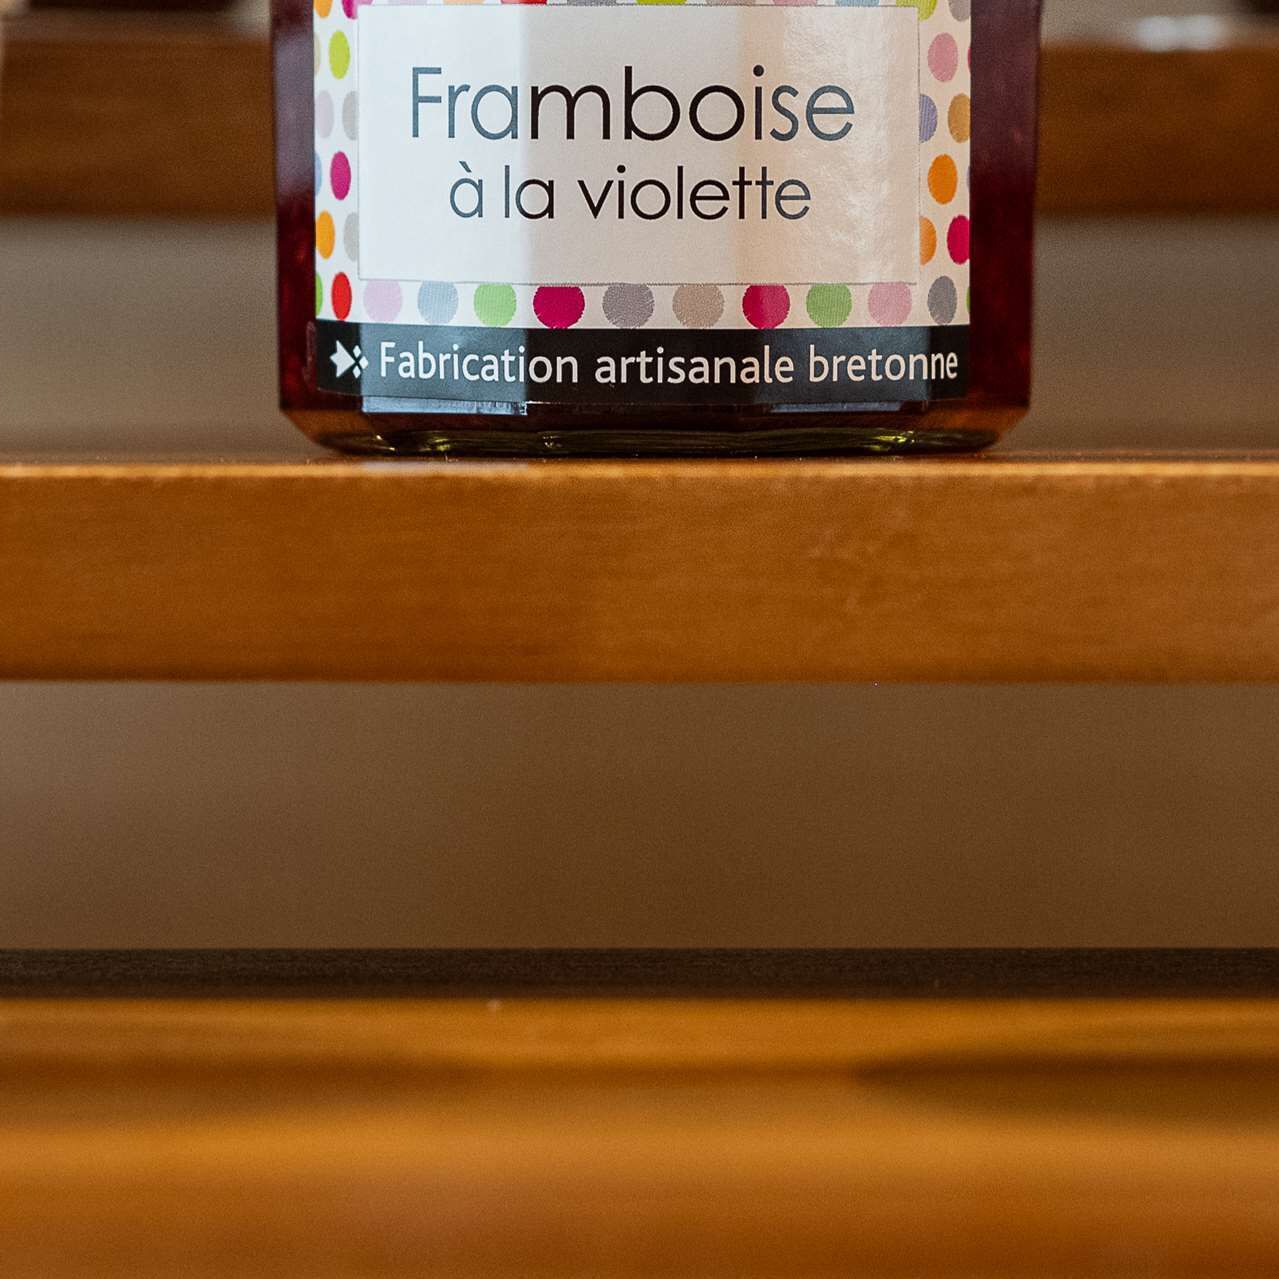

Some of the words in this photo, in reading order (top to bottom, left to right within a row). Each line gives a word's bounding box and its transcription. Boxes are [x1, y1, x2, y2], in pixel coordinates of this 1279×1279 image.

[410, 64, 857, 142] Framboise
[449, 159, 484, 220] à
[503, 163, 555, 220] la
[576, 164, 812, 221] violette
[379, 340, 580, 385] Fabrication
[593, 343, 796, 386] artisanale
[808, 342, 959, 385] bretonne
